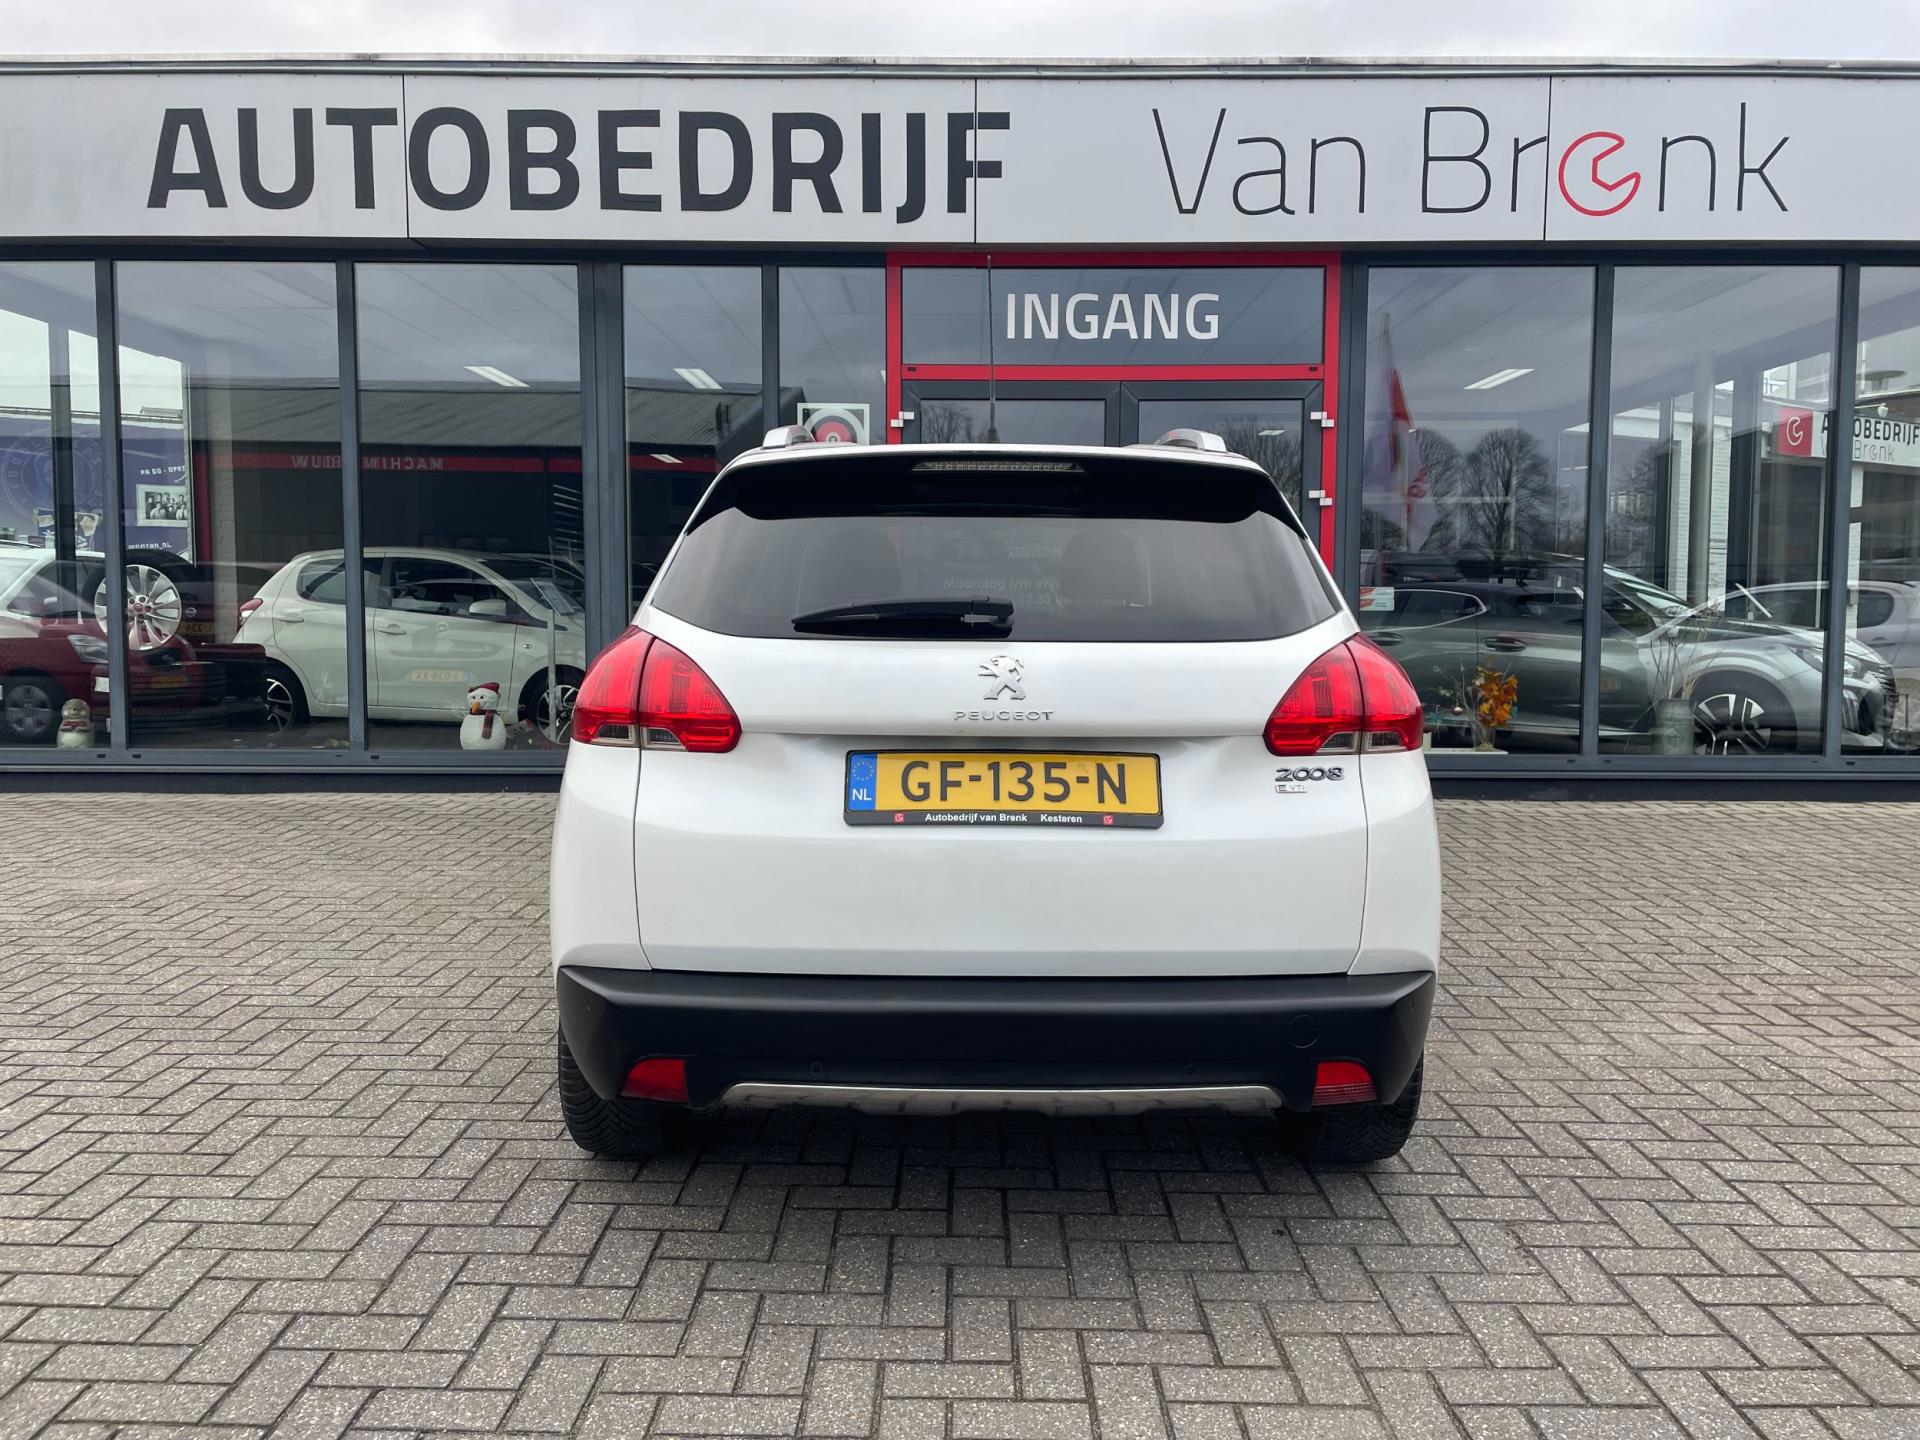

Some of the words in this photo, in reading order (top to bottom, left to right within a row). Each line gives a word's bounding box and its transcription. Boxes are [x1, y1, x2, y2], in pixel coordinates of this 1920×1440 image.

[148, 107, 1010, 224] AUTOBEDRIJF
[1152, 107, 1366, 216] Van
[1006, 292, 1220, 341] INGANG
[944, 577, 1006, 592] Maandag
[954, 710, 1054, 721] PEUGEOT
[1275, 766, 1345, 782] 2008
[852, 788, 872, 801] NL
[901, 760, 1127, 805] GF-135-N
[925, 813, 978, 823] Autobedrijf
[999, 813, 1028, 823] Brenk
[1040, 814, 1083, 824] Kesteren
